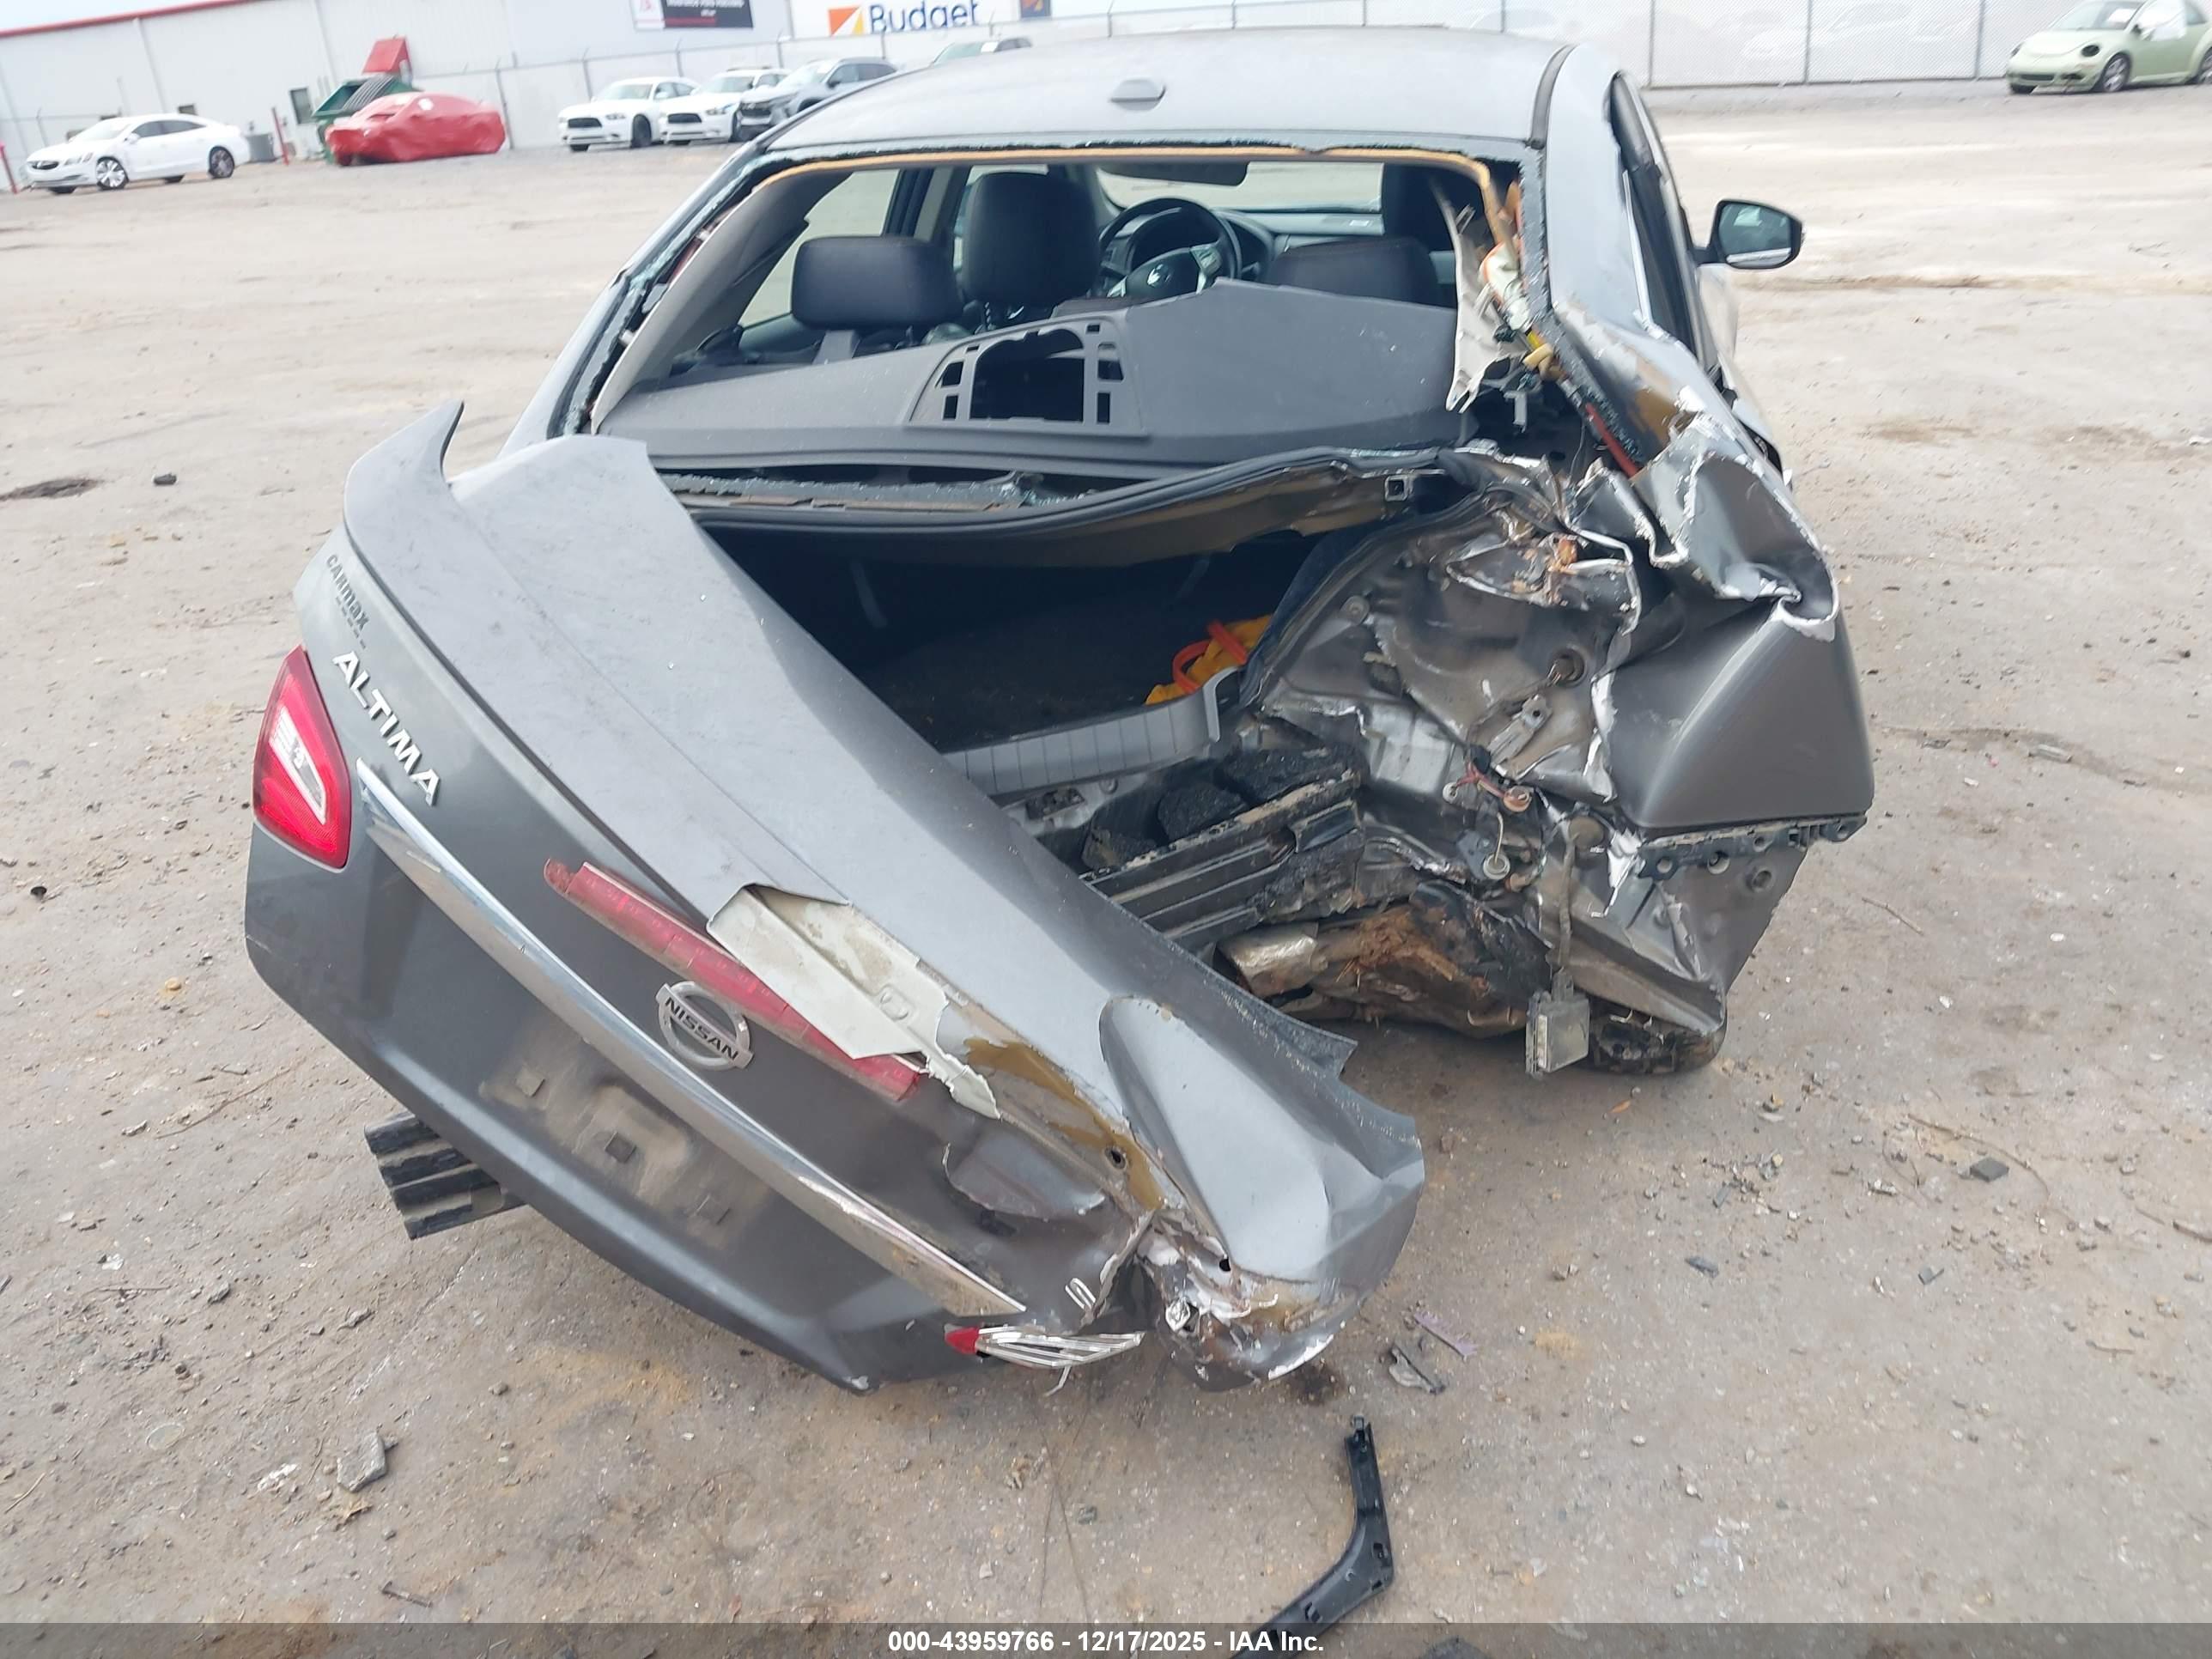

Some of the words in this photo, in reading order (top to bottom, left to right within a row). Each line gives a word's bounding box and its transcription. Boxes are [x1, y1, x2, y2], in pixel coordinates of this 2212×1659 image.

[868, 0, 981, 34] Budget
[332, 650, 441, 807] ALTIMA
[665, 996, 739, 1060] NISSAN
